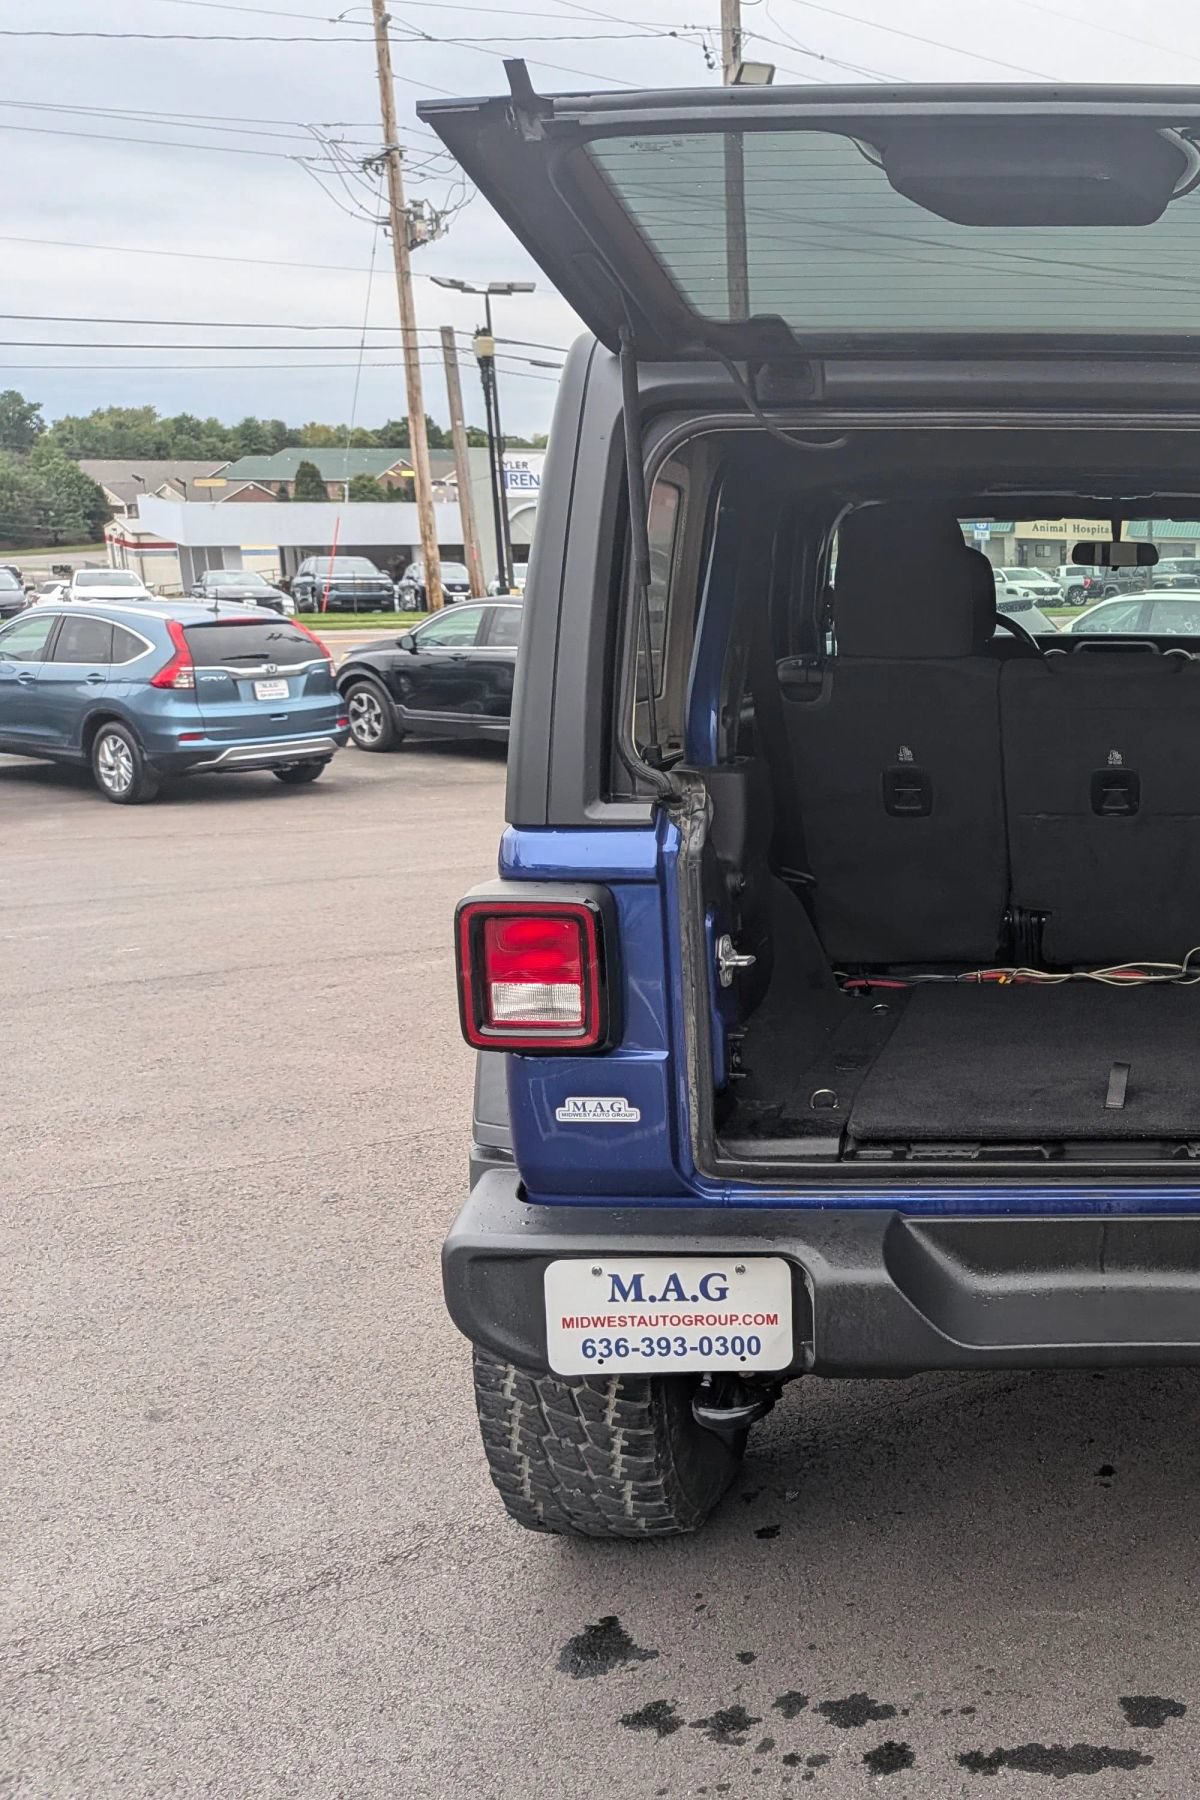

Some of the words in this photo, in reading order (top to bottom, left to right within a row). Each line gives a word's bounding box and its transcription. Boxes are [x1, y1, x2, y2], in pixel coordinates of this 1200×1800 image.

[1032, 523, 1067, 533] Animal
[1072, 524, 1112, 536] Hospita
[572, 1101, 623, 1113] M.A.G
[607, 1272, 730, 1303] M.A.G
[561, 1313, 779, 1329] MIDWESTAUTOGROUP.COM
[581, 1335, 762, 1359] 636-393-0300
